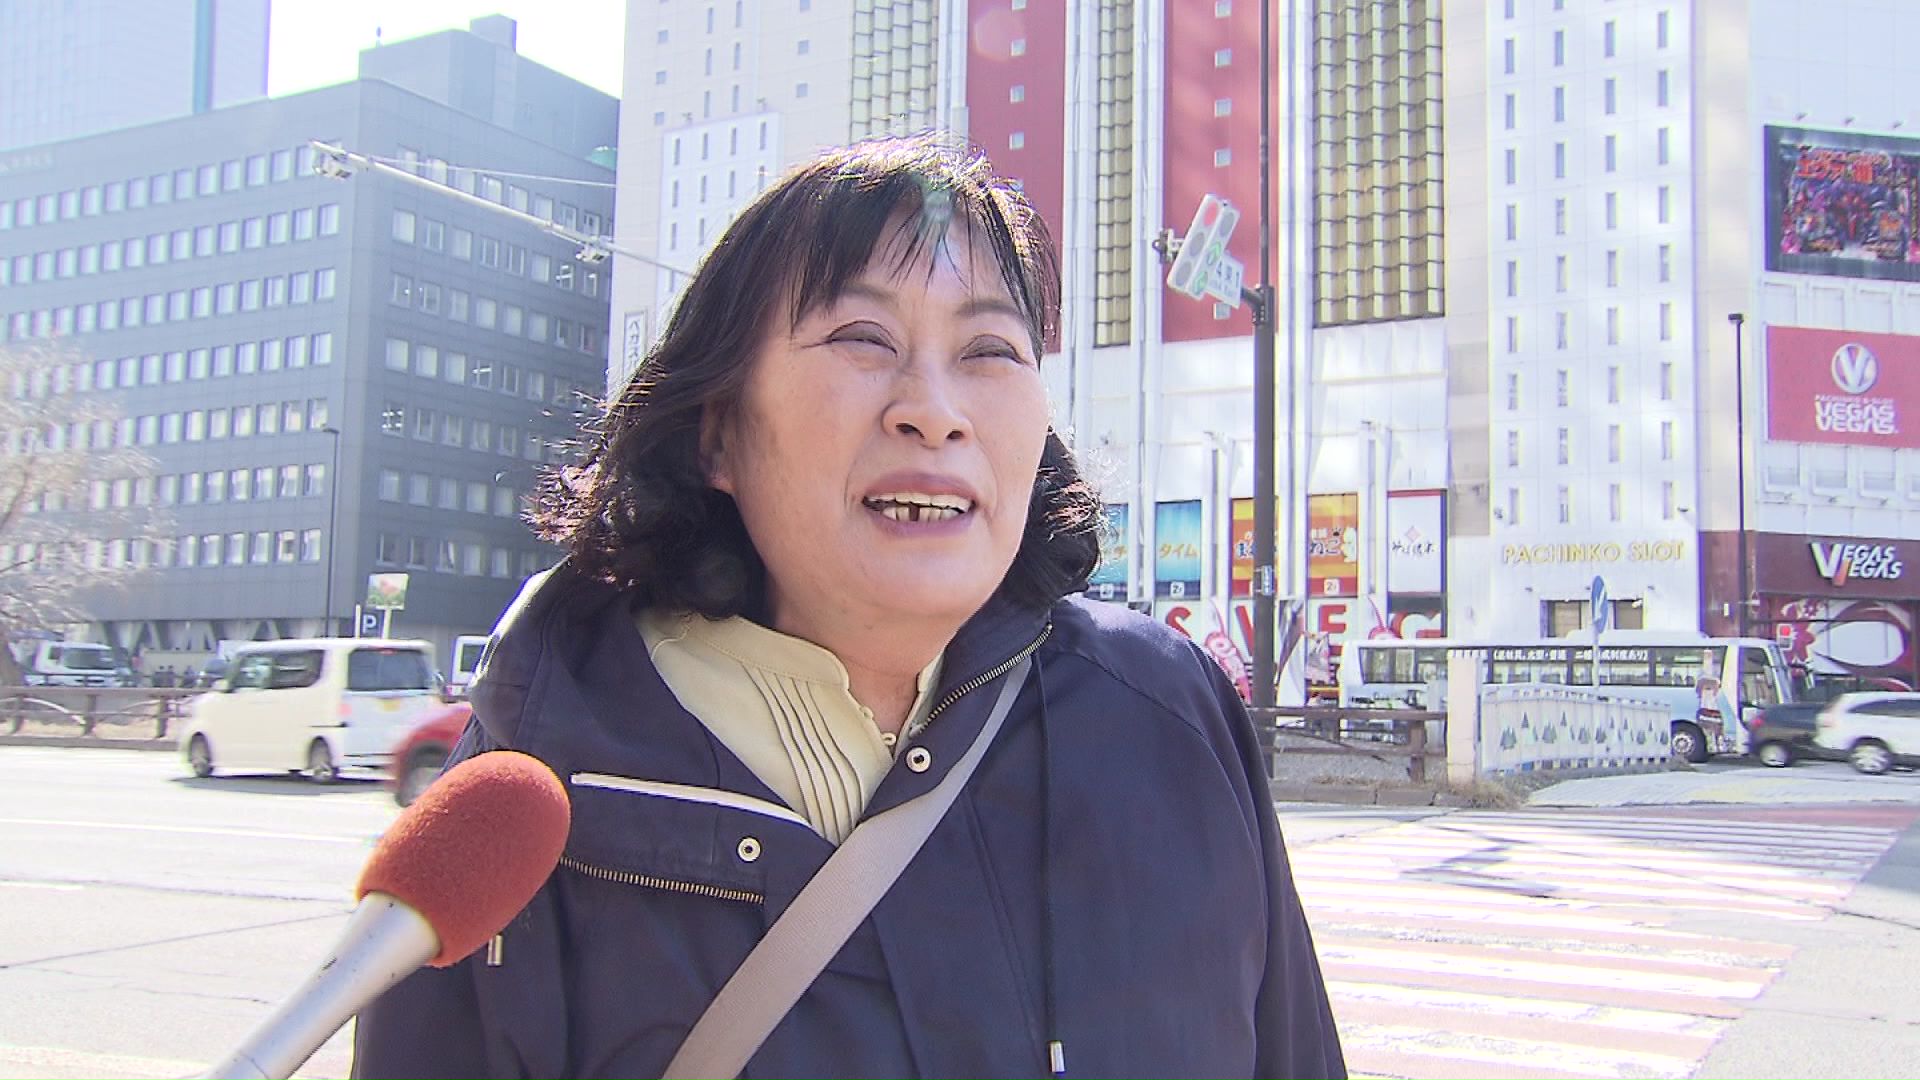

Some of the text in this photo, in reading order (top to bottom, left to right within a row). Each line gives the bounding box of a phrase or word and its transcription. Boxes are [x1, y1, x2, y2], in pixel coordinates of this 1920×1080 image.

[1815, 400, 1895, 418] VEGAS
[1815, 416, 1895, 434] VEGAS
[1159, 544, 1200, 558] タイム
[1503, 539, 1685, 564] PACHINKO SLOT
[1809, 543, 1896, 577] VEGAS
[363, 614, 377, 634] P
